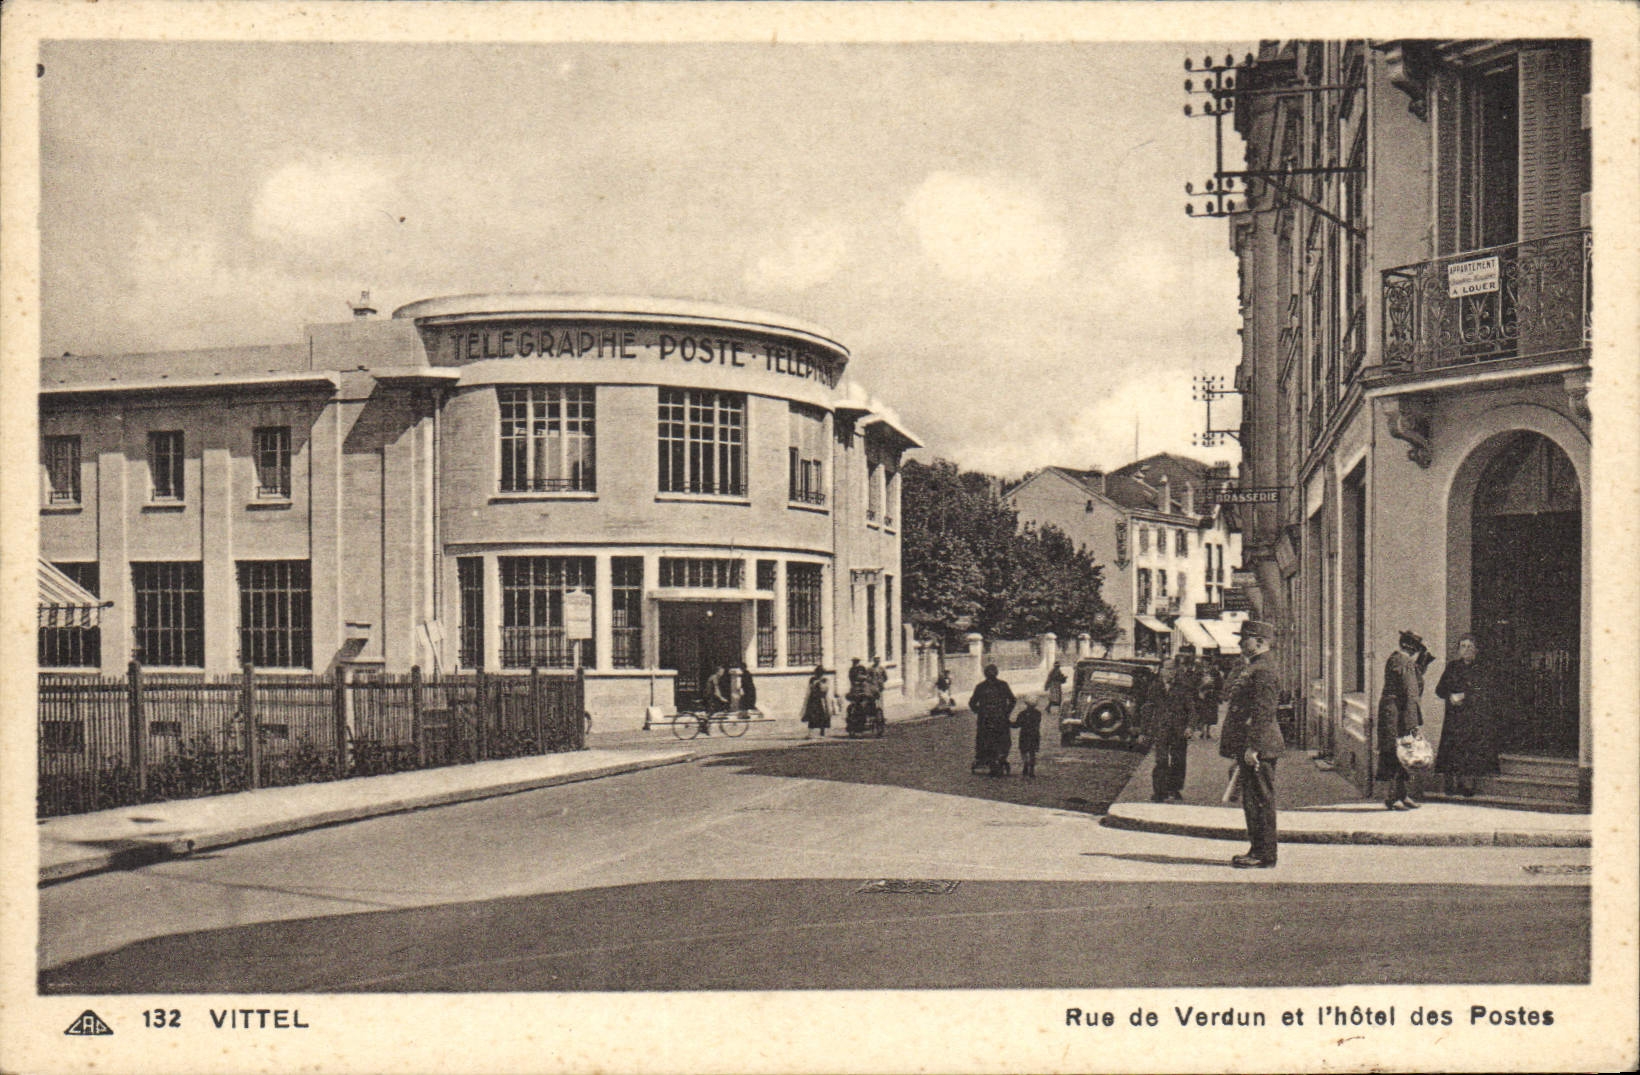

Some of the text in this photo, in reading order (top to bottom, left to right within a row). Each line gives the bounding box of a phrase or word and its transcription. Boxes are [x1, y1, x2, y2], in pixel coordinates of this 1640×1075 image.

[1450, 259, 1496, 274] APPARTEMENT
[1462, 281, 1496, 294] LOUER
[659, 333, 745, 368] POSTE
[1216, 491, 1279, 503] BRASSERIE
